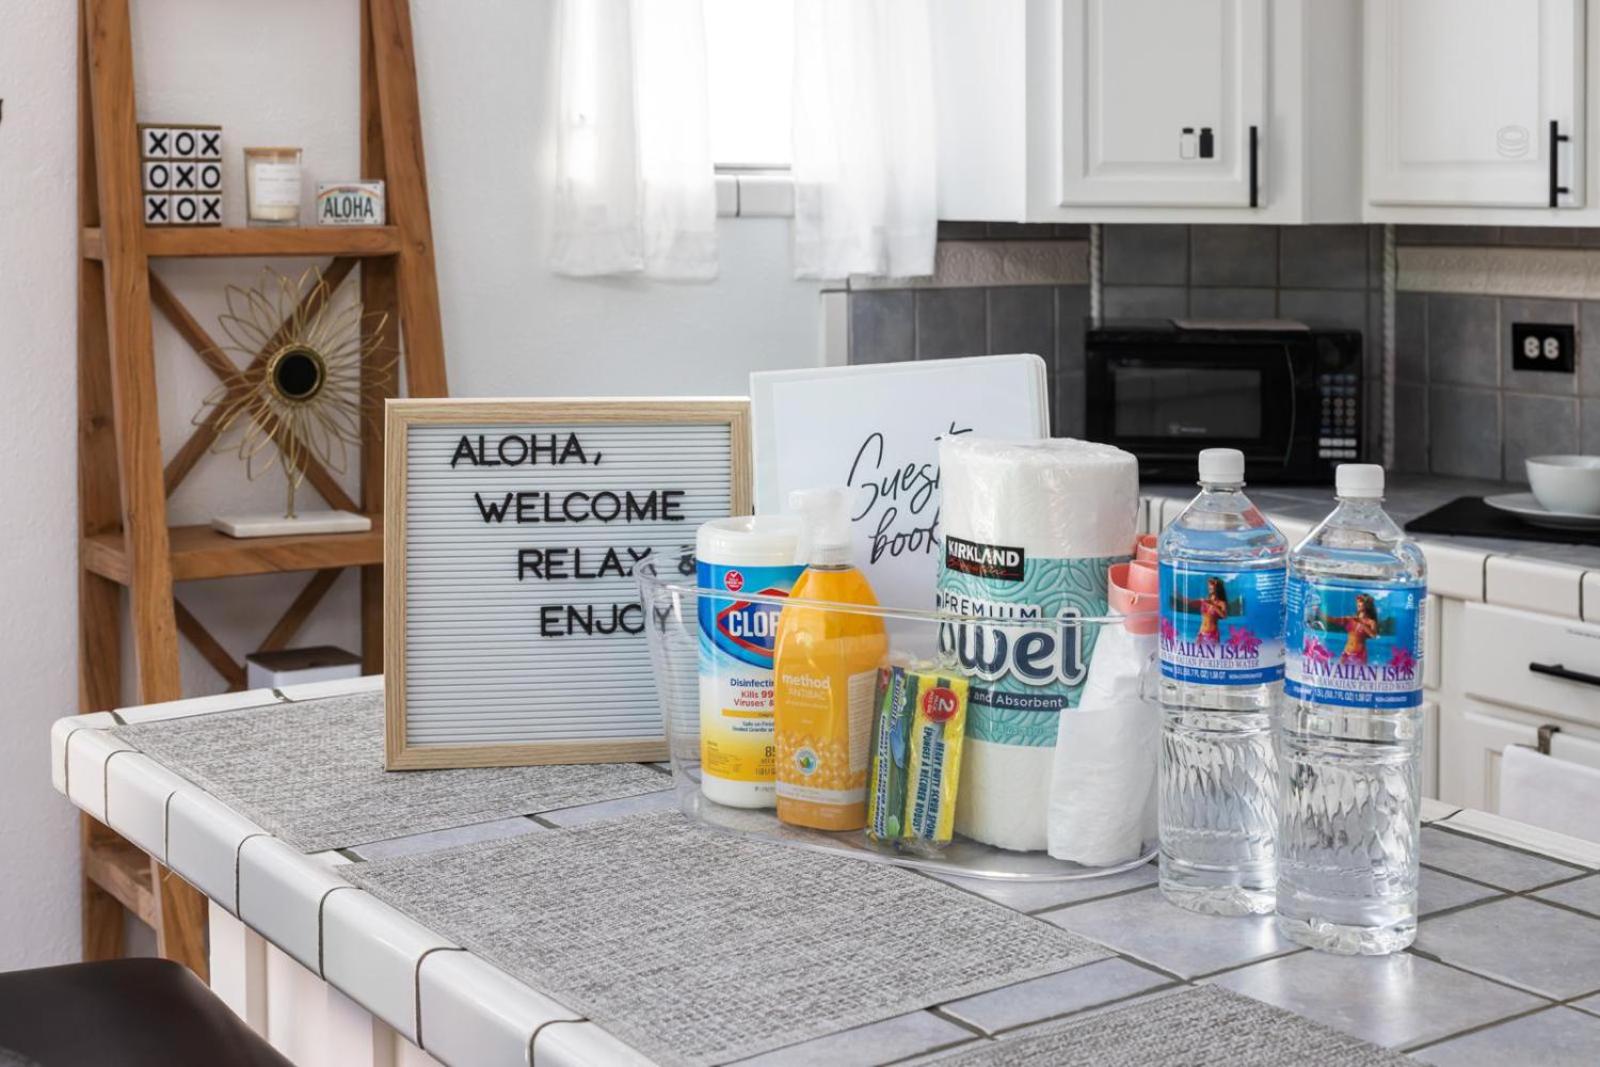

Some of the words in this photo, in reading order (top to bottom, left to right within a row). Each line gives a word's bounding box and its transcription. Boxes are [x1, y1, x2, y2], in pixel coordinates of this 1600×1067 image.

[323, 196, 374, 218] ALOHA
[450, 432, 602, 469] ALOHA,
[474, 490, 686, 524] WELCOME
[517, 547, 658, 581] RELAX
[947, 540, 1020, 567] KIRKLAND
[540, 603, 674, 637] ENJOY
[783, 673, 831, 689] method
[741, 690, 759, 699] Kills
[939, 699, 954, 712] 2
[995, 695, 1063, 708] Absorbent
[934, 741, 945, 767] HEAVY
[932, 768, 942, 788] DUTY
